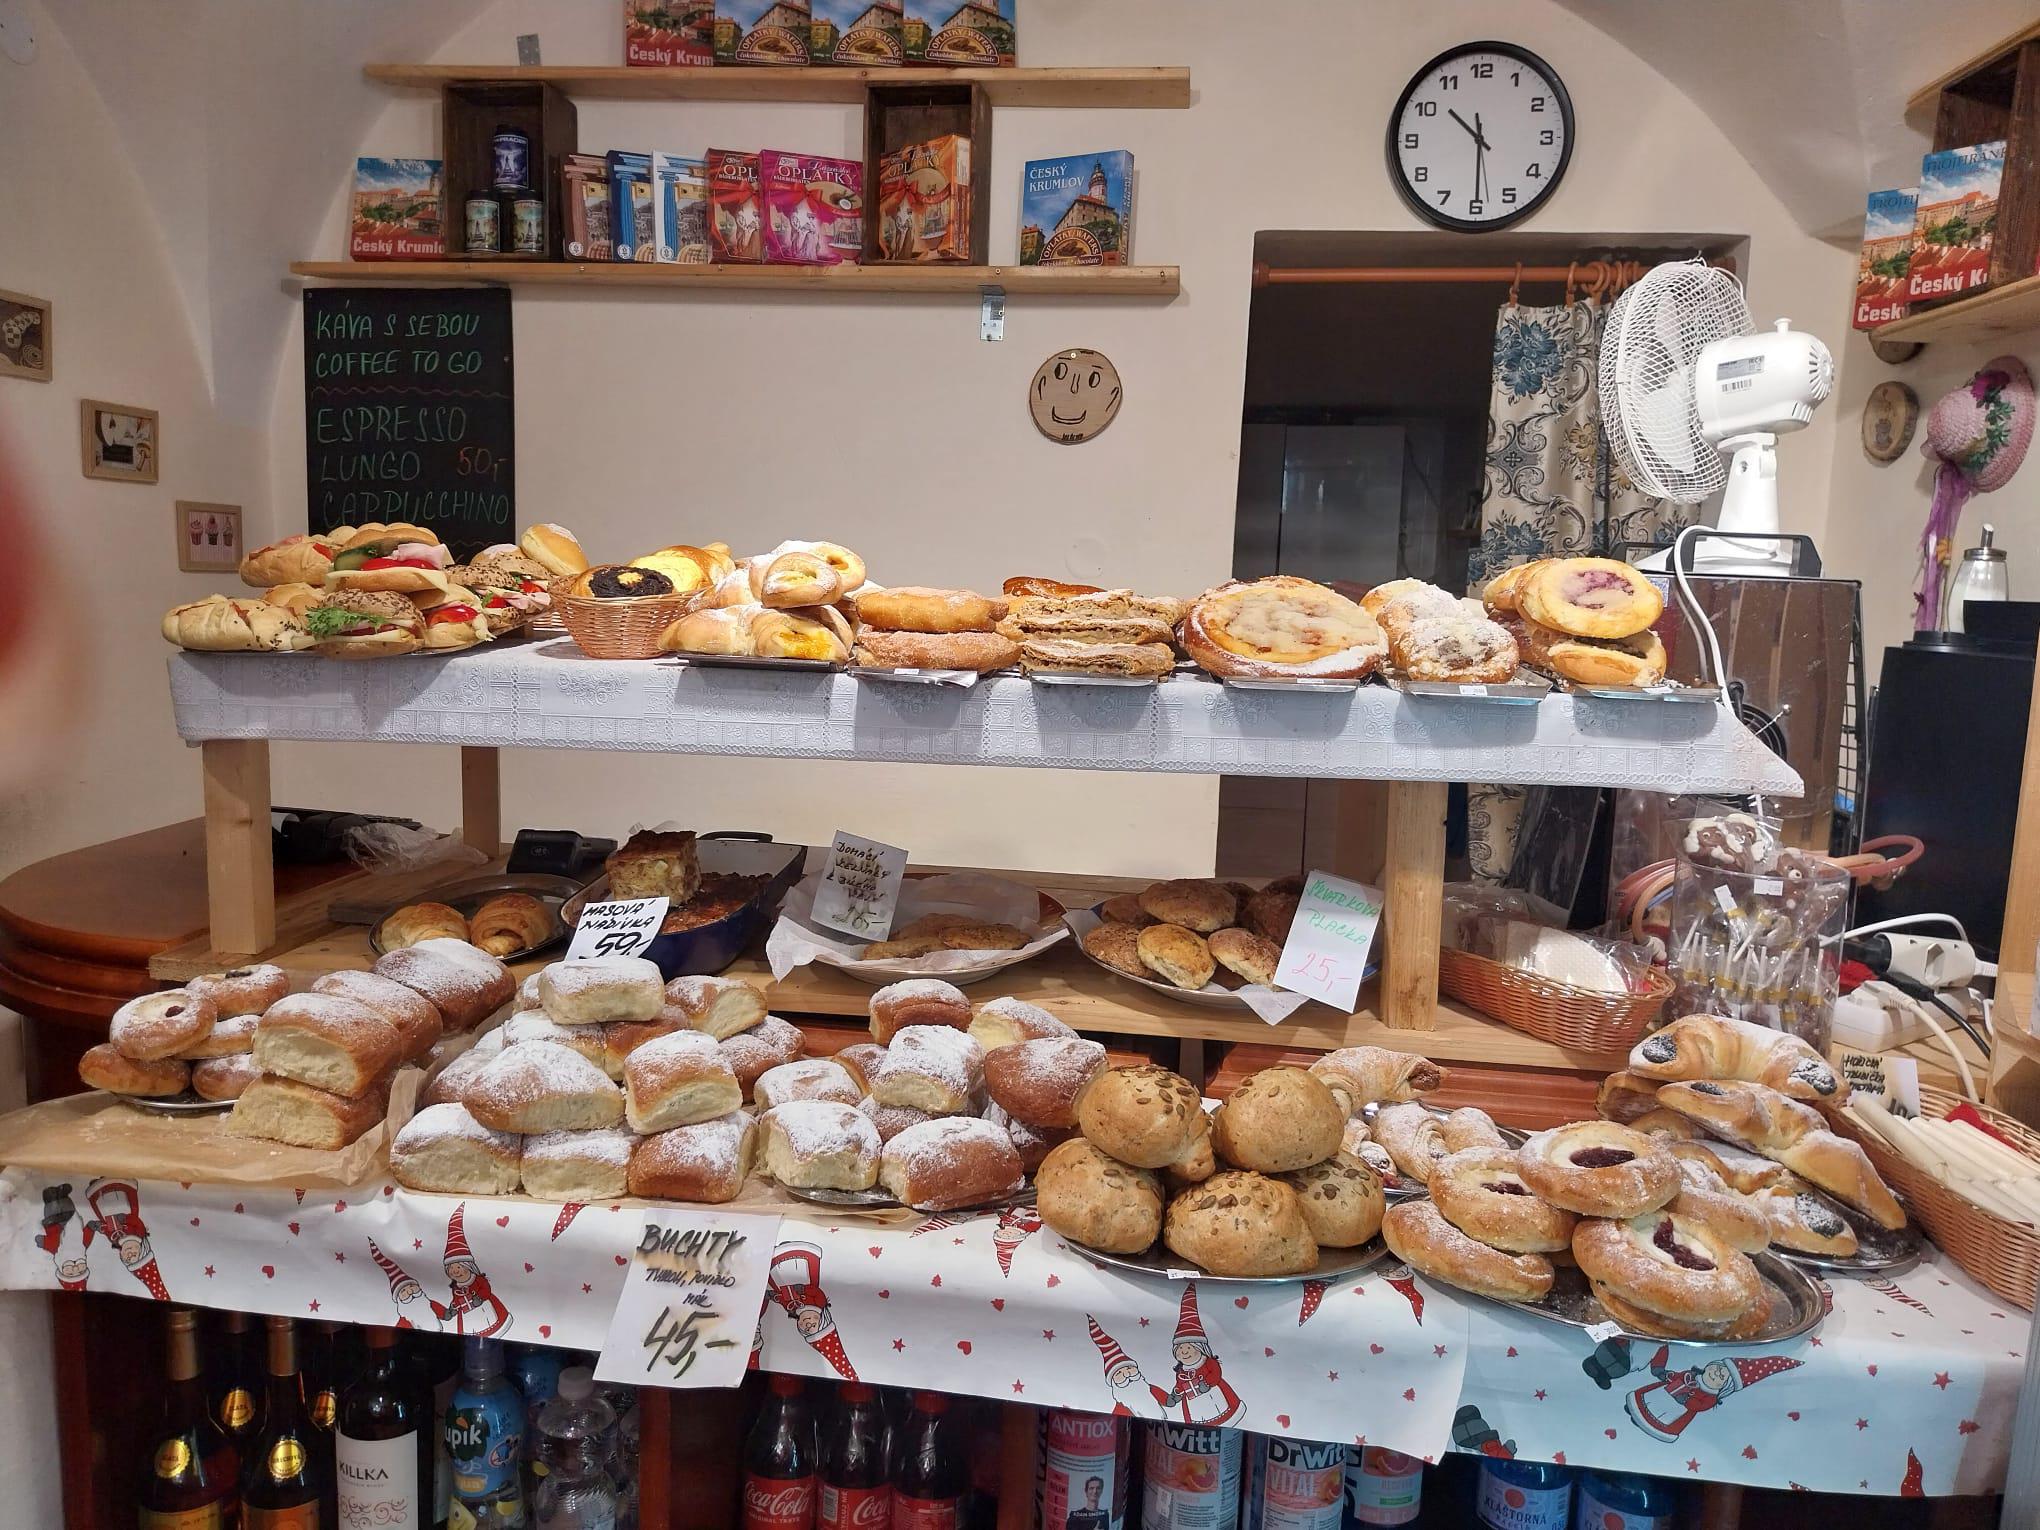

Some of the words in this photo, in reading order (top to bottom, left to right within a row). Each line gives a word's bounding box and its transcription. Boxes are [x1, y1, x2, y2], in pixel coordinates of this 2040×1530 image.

[629, 44, 672, 66] Český
[1470, 63, 1494, 78] 12
[1439, 75, 1458, 90] 11
[1510, 73, 1520, 87] 1
[1414, 101, 1437, 116] 10
[1531, 97, 1544, 112] 2
[1404, 133, 1419, 149] 9
[1539, 130, 1554, 145] 3
[1029, 163, 1068, 179] ČESKÝ
[1414, 166, 1428, 182] 8
[1525, 163, 1541, 179] 4
[1029, 176, 1085, 193] KRUMLOV
[1437, 190, 1451, 205] 7
[1502, 187, 1517, 203] 5
[1469, 199, 1483, 215] 6
[353, 234, 393, 256] Český
[1909, 271, 1964, 296] Český
[316, 300, 373, 341] KÁVA
[384, 313, 396, 336] S
[405, 313, 480, 338] SEBOU
[315, 350, 401, 378] COFFEE
[411, 350, 440, 374] TO
[448, 350, 483, 375] GO
[317, 405, 467, 444] ESPRESSO
[319, 450, 421, 482] LUNGO
[323, 490, 509, 529] CAPPUCCHINO
[1302, 907, 1368, 945] PLACKA
[636, 1224, 748, 1262] BUCHTY
[1052, 1415, 1114, 1439] ANTIOX
